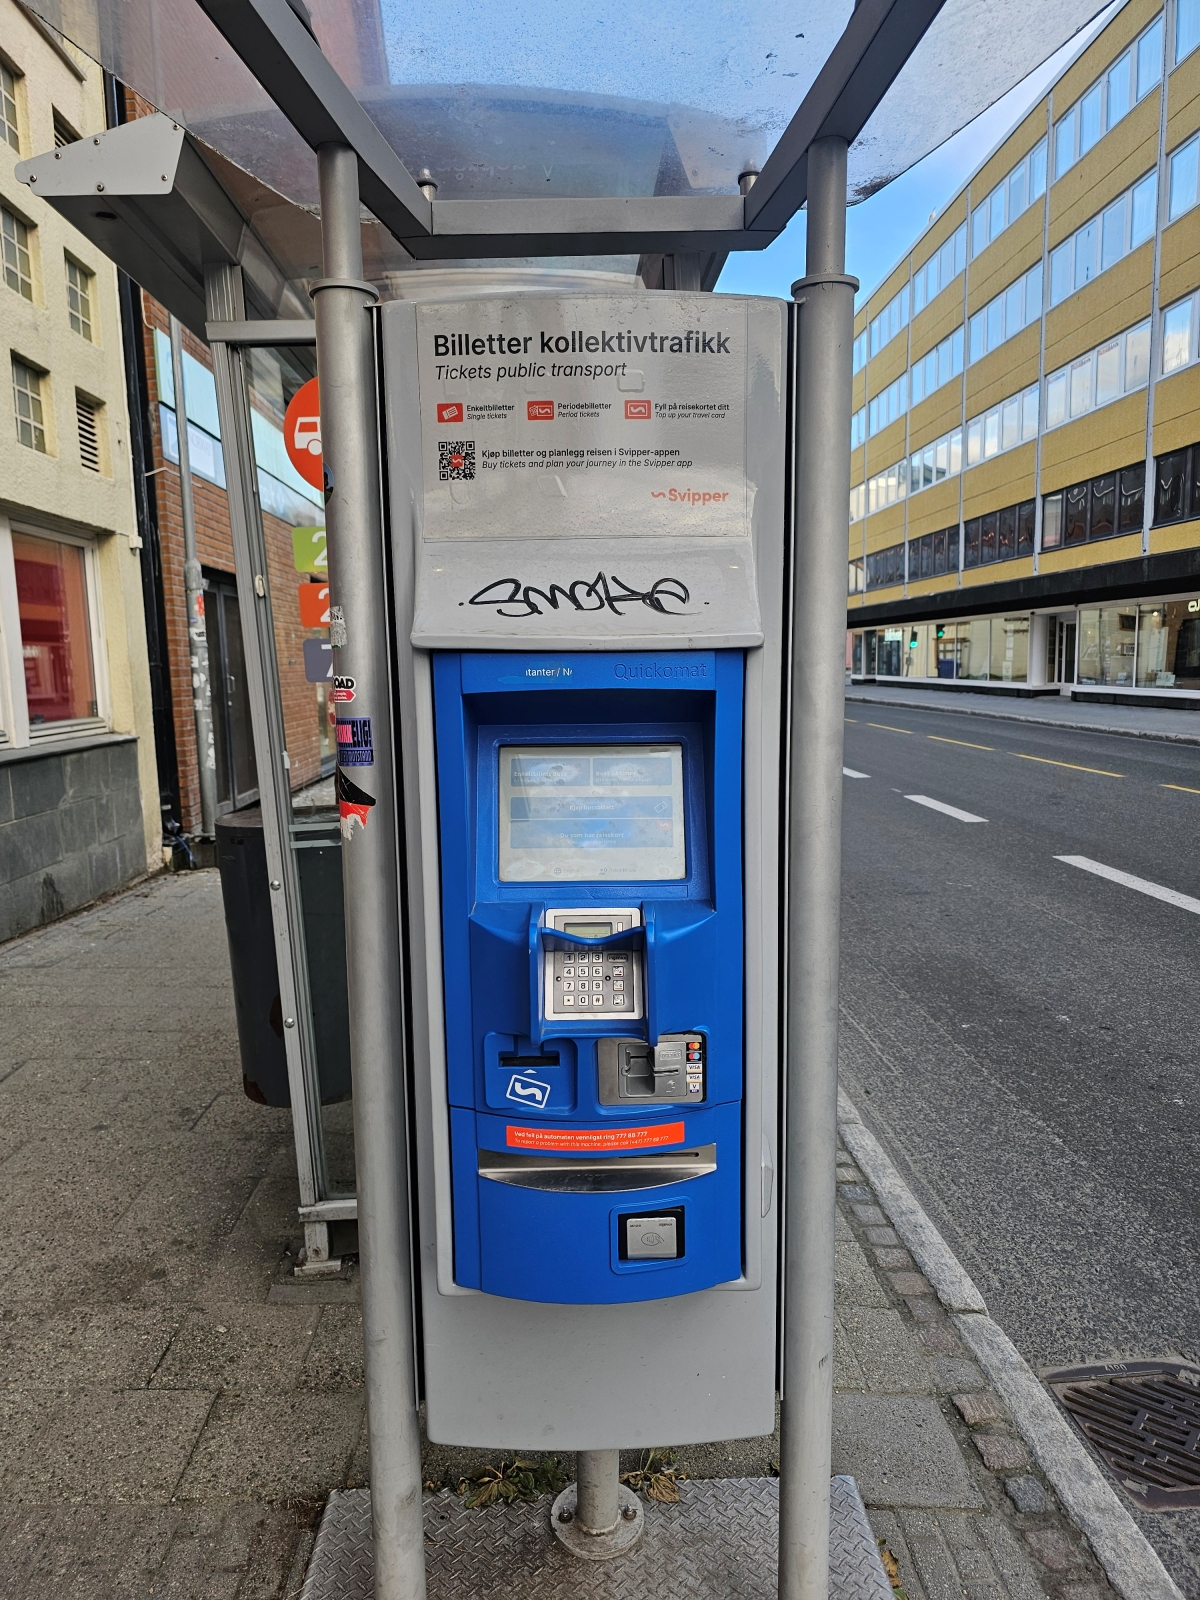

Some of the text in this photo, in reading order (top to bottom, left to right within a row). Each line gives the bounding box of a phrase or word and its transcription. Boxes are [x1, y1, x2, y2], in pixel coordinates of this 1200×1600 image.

[433, 331, 731, 357] Billetter kollektivtrafikk
[435, 362, 627, 382] Tickets public transport
[466, 404, 515, 412] Enkeltbilletter
[557, 402, 612, 410] Periodebilletter
[654, 402, 730, 411] Fyll på reisekortet ditt
[467, 412, 507, 421] Single tickets
[558, 411, 578, 419] Period
[655, 411, 667, 419] Top
[482, 449, 500, 459] Kjøp
[502, 449, 534, 457] billetter
[548, 448, 585, 458] planlegg
[586, 447, 612, 456] reisen
[618, 447, 680, 457] Svipper-appen
[482, 460, 498, 470] Buy
[499, 460, 526, 468] tickets
[545, 460, 564, 469] plan
[585, 459, 617, 468] journey
[618, 459, 627, 467] in
[628, 459, 642, 467] the
[643, 459, 676, 468] Svipper
[676, 459, 693, 468] app
[668, 488, 729, 506] Svipper
[614, 662, 707, 681] Quickomat
